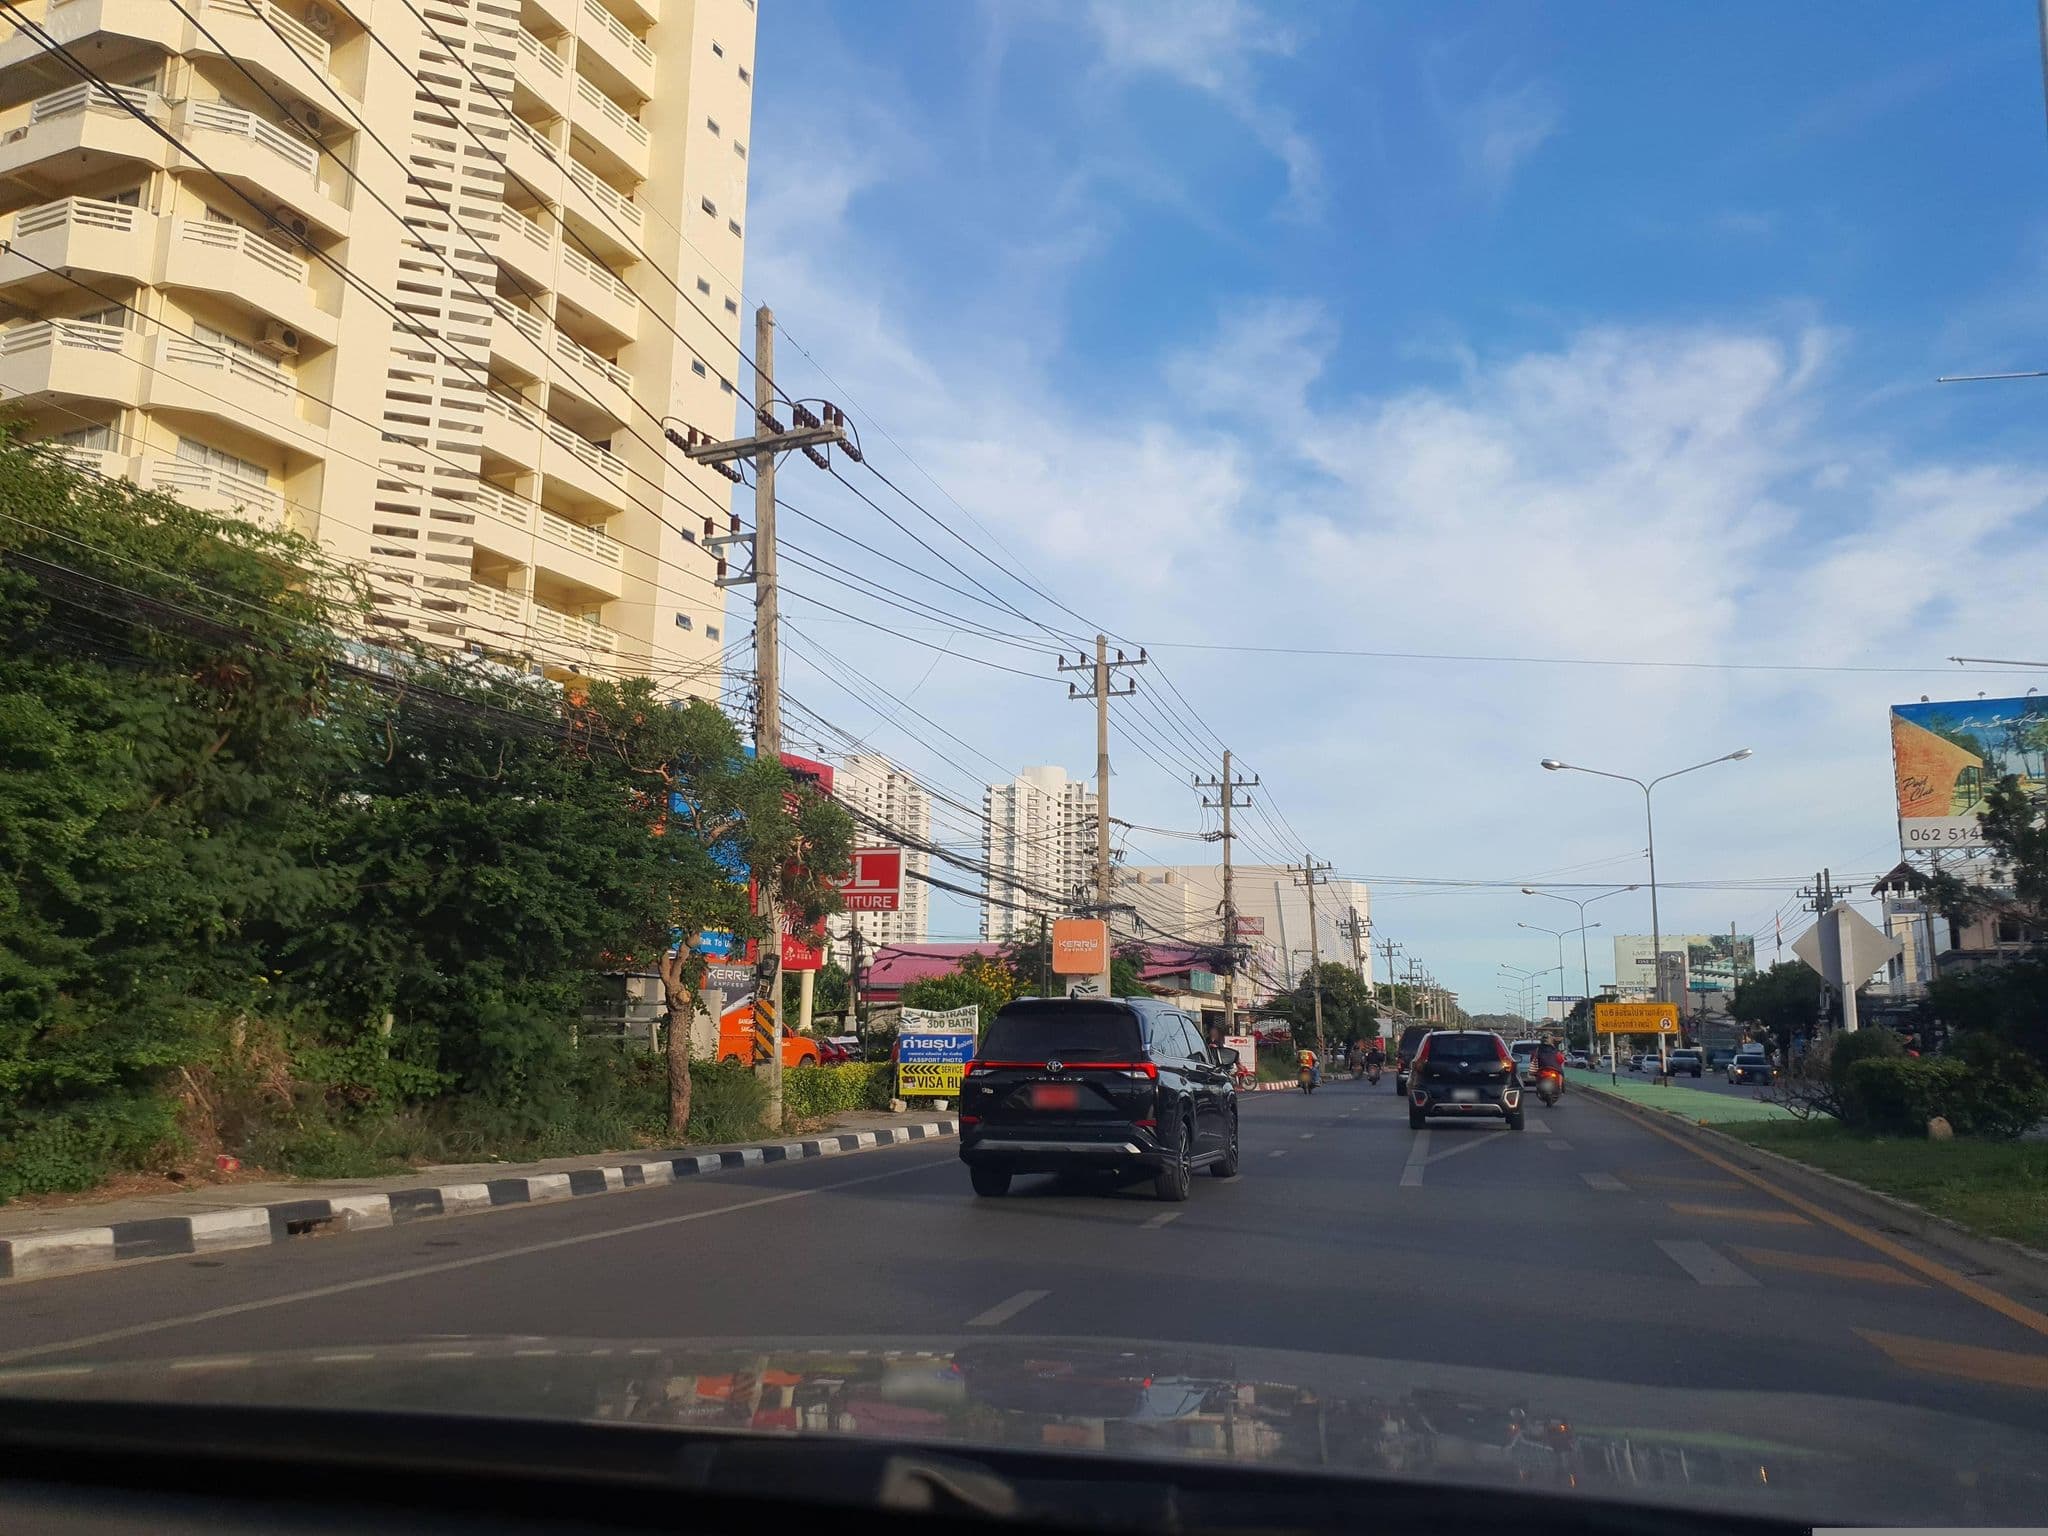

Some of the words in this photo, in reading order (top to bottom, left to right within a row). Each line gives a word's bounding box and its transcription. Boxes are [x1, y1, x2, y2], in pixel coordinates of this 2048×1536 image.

[1910, 828, 1941, 841] 062
[1948, 827, 1985, 840] 514
[1059, 938, 1098, 948] KERRY
[708, 969, 750, 981] KERRY
[920, 1011, 936, 1019] ALL
[939, 1007, 977, 1019] STRAINS
[927, 1020, 945, 1029] 300
[948, 1018, 973, 1028] BATH
[941, 1065, 963, 1074] SERVICE
[918, 1076, 944, 1089] VISA
